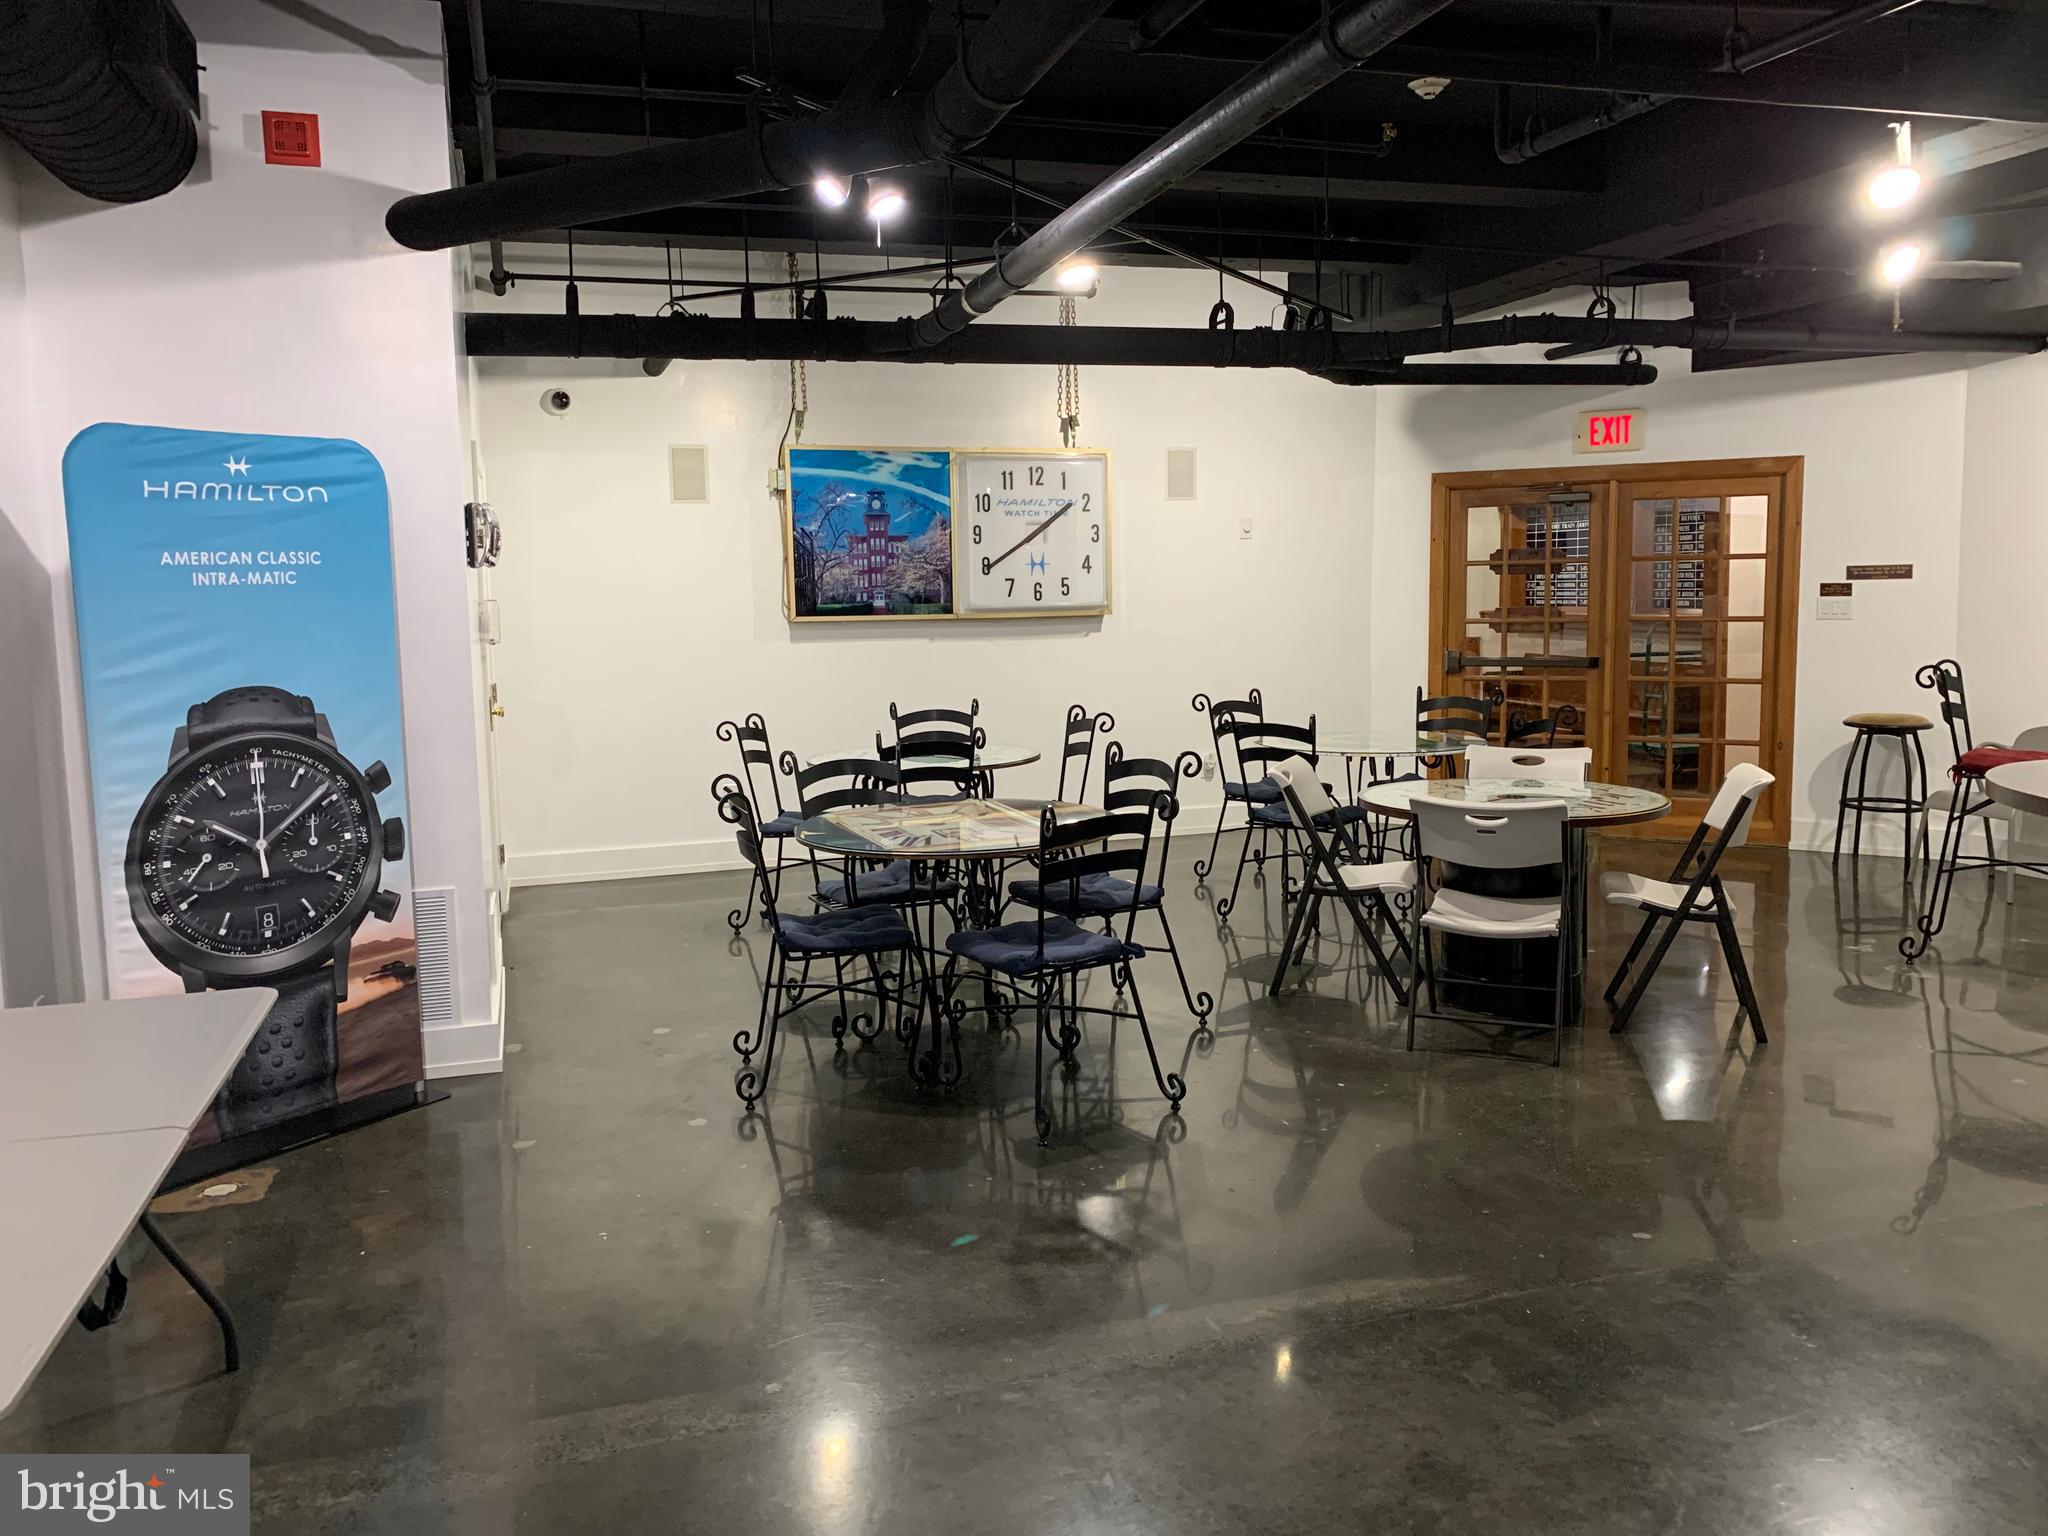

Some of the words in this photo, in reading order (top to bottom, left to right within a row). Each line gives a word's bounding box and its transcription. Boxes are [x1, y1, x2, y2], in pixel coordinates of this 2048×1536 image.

[1589, 414, 1632, 446] EXIT
[1001, 470, 1014, 490] 11
[1028, 466, 1044, 486] 12
[1060, 471, 1067, 490] 1
[143, 480, 328, 503] HAMILTON
[974, 493, 991, 513] 10
[996, 498, 1079, 507] HAMILTON
[1081, 493, 1091, 512] 2
[973, 525, 982, 545] 9
[1091, 524, 1100, 543] 3
[160, 551, 252, 566] AMERICAN
[257, 551, 322, 566] CLASSIC
[982, 556, 991, 576] 8
[1081, 555, 1092, 574] 4
[192, 571, 297, 586] INTRA-MATIC
[1004, 578, 1015, 597] 7
[1061, 577, 1070, 596] 5
[1034, 582, 1043, 601] 6
[271, 749, 330, 775] TACHYMETER
[335, 774, 349, 789] 400
[164, 793, 177, 806] 70
[350, 798, 362, 814] 300
[148, 829, 158, 843] 75
[199, 834, 216, 843] 60
[359, 826, 369, 844] 240
[292, 849, 308, 858] 20
[143, 862, 153, 876] 80
[183, 867, 198, 876] 40
[217, 861, 234, 871] 20
[356, 856, 366, 874] 200
[150, 891, 161, 905] 85
[161, 913, 174, 926] 90
[263, 912, 274, 928] 8
